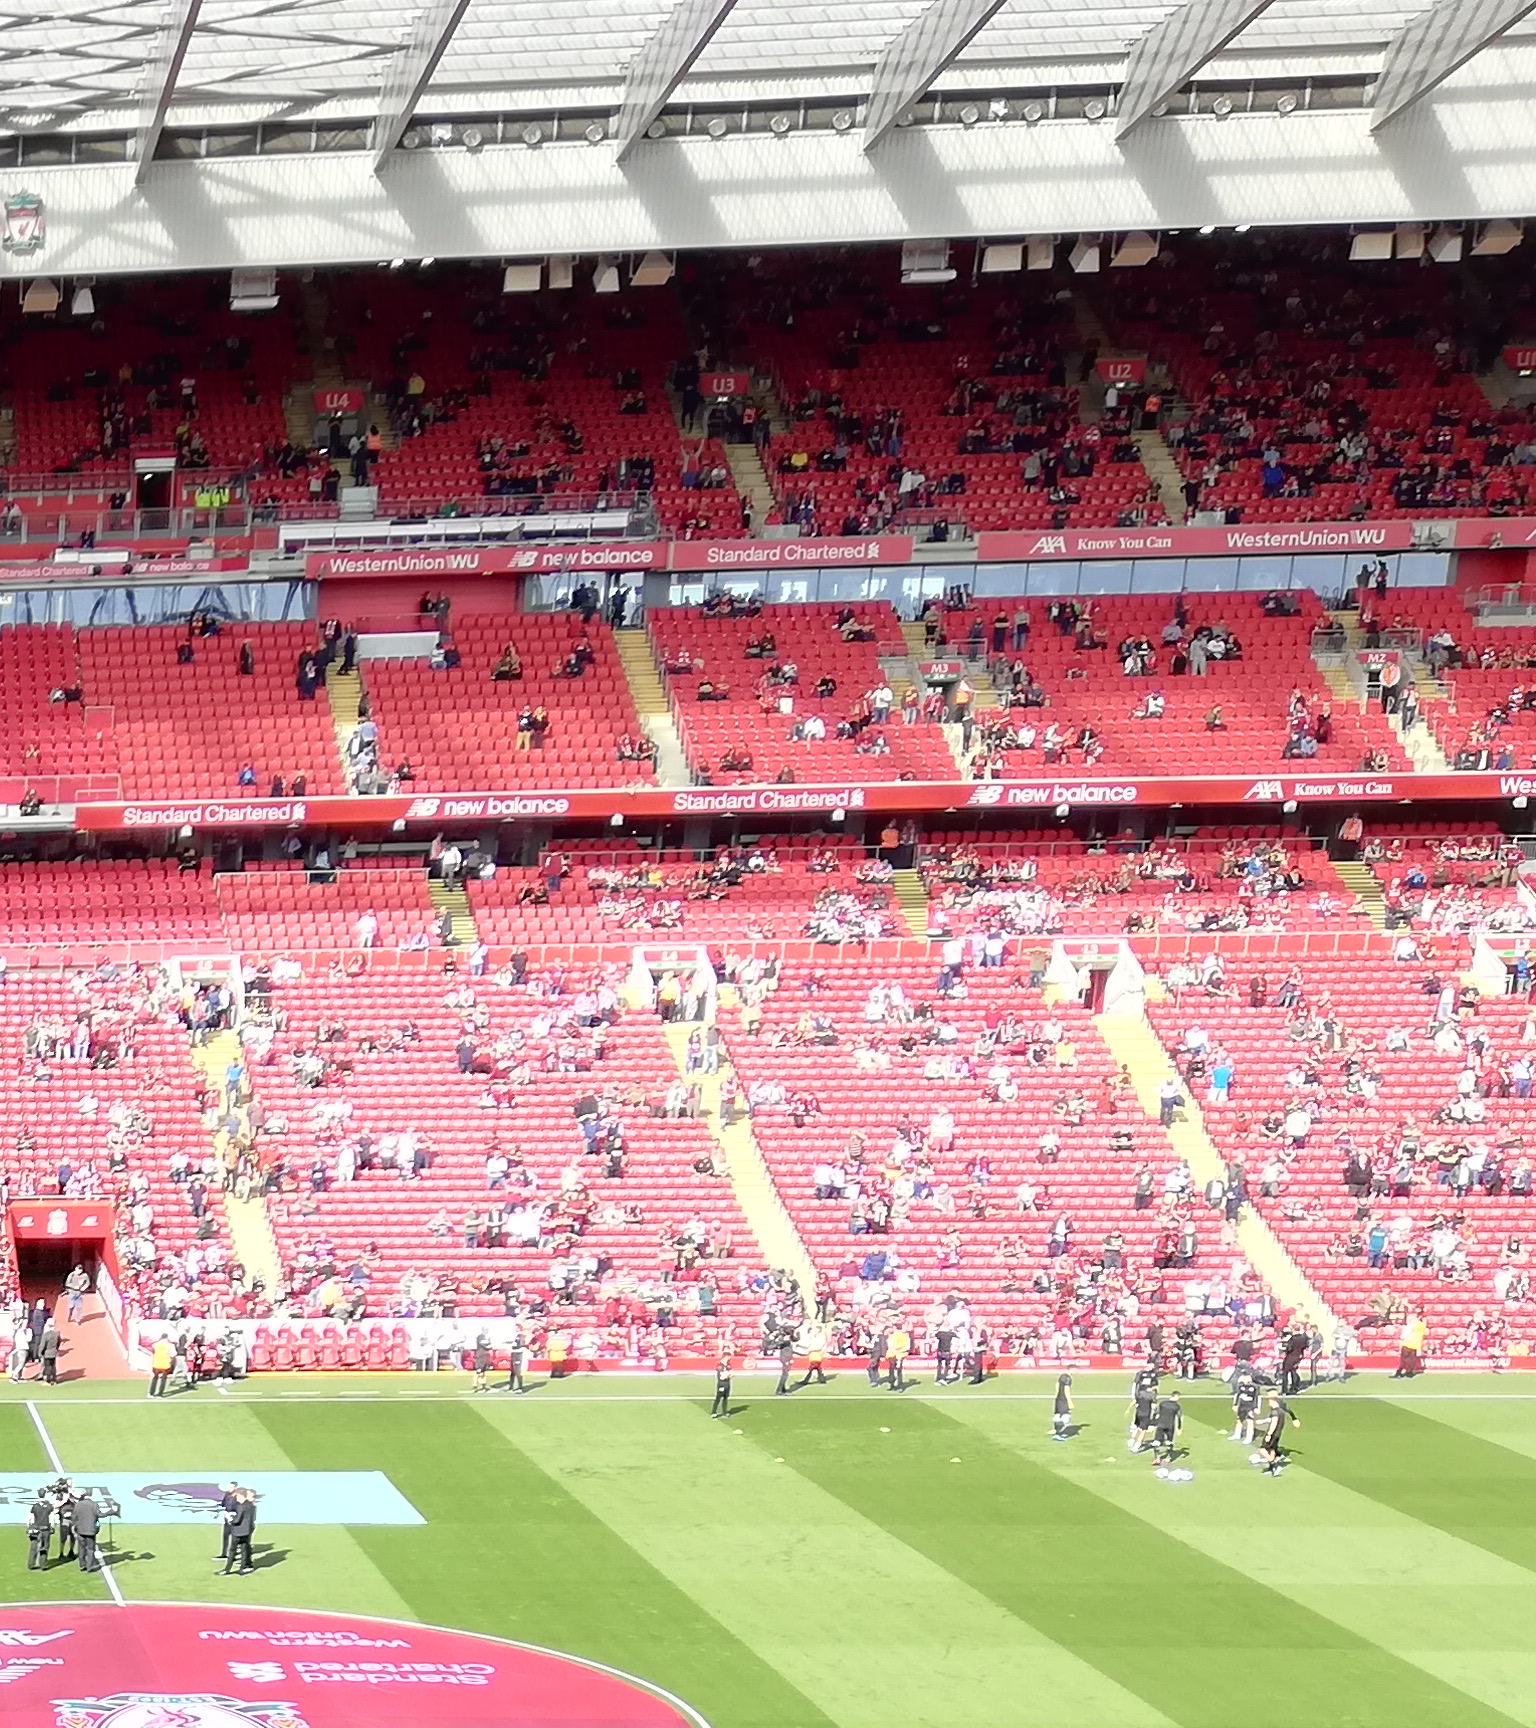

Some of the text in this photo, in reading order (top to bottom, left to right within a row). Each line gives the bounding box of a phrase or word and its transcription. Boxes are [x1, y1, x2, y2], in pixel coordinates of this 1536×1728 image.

[1109, 365, 1132, 379] U2
[712, 378, 735, 392] U3
[326, 394, 349, 408] U4
[1030, 536, 1171, 553] AXA Know You Can
[542, 550, 577, 565] new
[581, 548, 653, 564] balance
[707, 544, 865, 563] Standard Chartered
[0, 566, 87, 578] Standard Chartered
[171, 561, 209, 571] balace
[931, 664, 949, 673] M3
[1008, 787, 1048, 803] new
[1052, 785, 1138, 801] balance
[1244, 781, 1393, 799] AXA Know You Can
[445, 800, 483, 815] new
[487, 797, 569, 814] balance
[674, 790, 848, 810] Standard Chartered
[123, 803, 291, 823] Standard Chartered
[7, 1657, 65, 1666] new
[293, 1661, 496, 1674] Chartered
[300, 1672, 489, 1685] Standard
